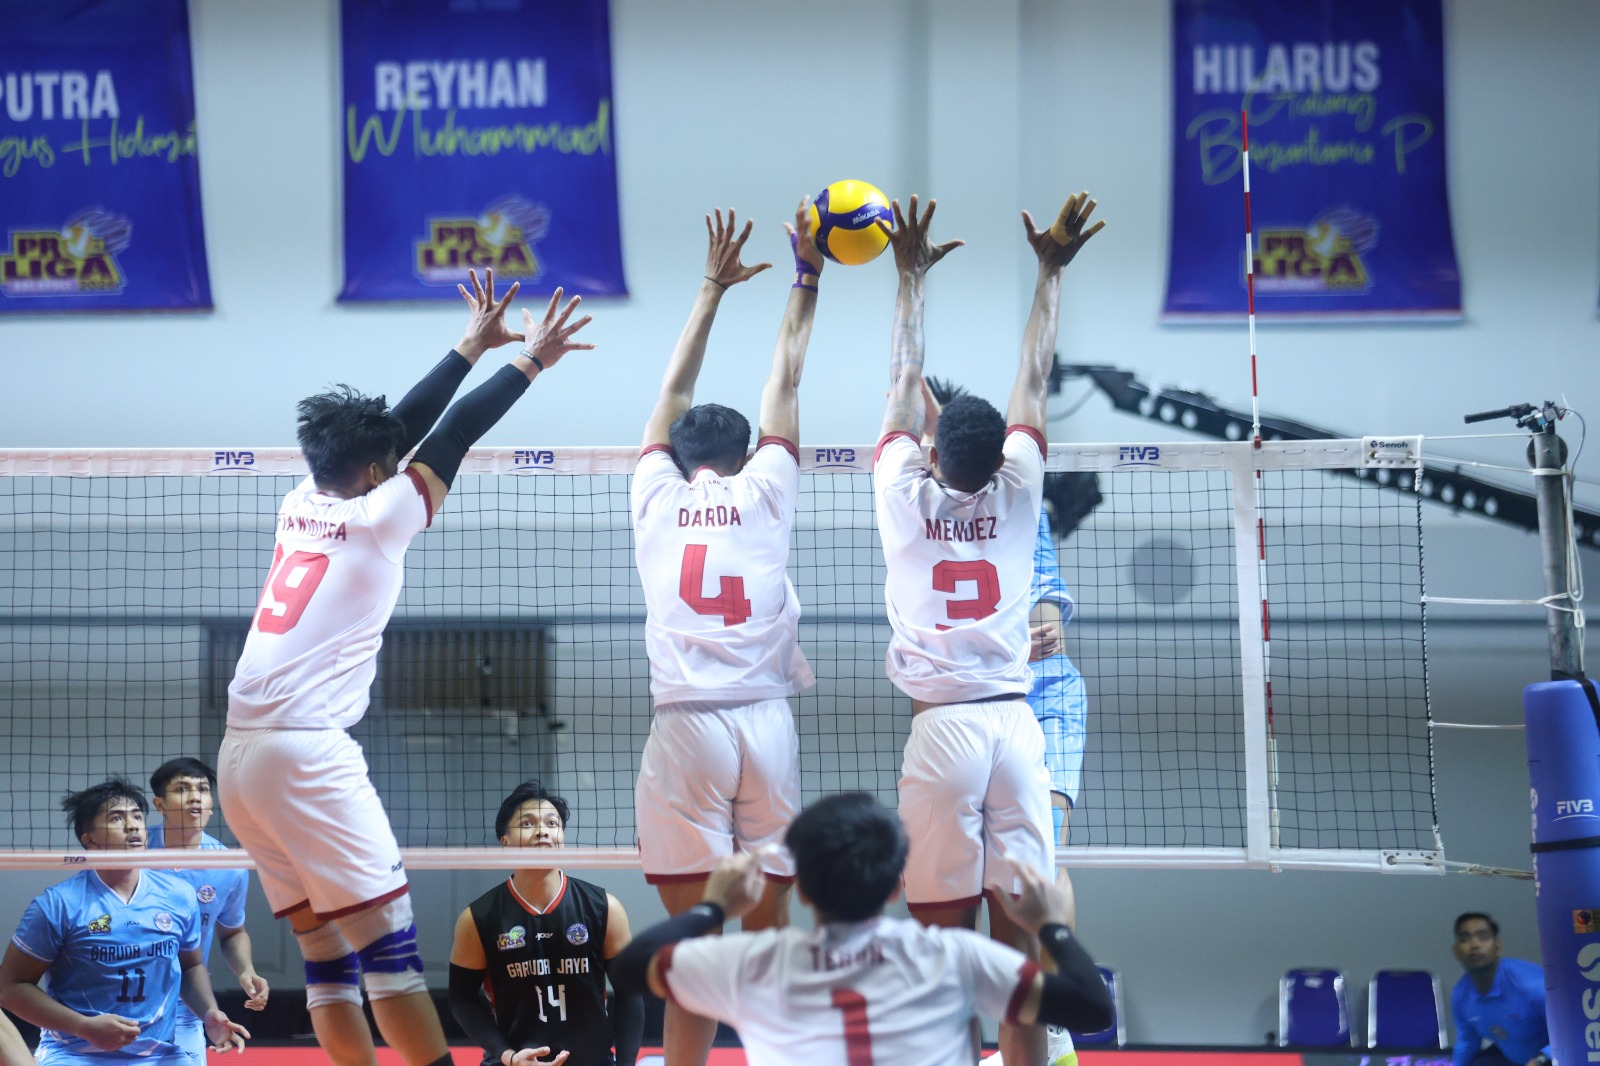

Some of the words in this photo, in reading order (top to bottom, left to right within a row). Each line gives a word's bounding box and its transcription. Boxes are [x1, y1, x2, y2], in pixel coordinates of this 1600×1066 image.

[1192, 41, 1382, 93] HILARUS
[374, 58, 547, 111] REYHAN
[347, 88, 610, 163] Muhammad
[1380, 113, 1434, 175] P
[4, 254, 115, 280] LIGA
[423, 243, 528, 268] LIGA
[1252, 253, 1357, 278] LIGA
[513, 450, 555, 465] FIVB
[814, 448, 857, 463] FIVB
[1118, 446, 1160, 461] FIVB
[1379, 441, 1408, 449] Senoh
[214, 450, 256, 466] FIVB
[678, 505, 742, 527] DARDA
[925, 516, 998, 543] MENDEZ
[679, 543, 752, 628] 4
[1556, 798, 1595, 815] FIVB
[91, 944, 141, 961] GARUDA
[506, 958, 551, 978] GARUDA
[557, 957, 590, 975] JAYA
[116, 967, 146, 1002] 11
[535, 984, 567, 1023] 14
[830, 985, 876, 1066] 1
